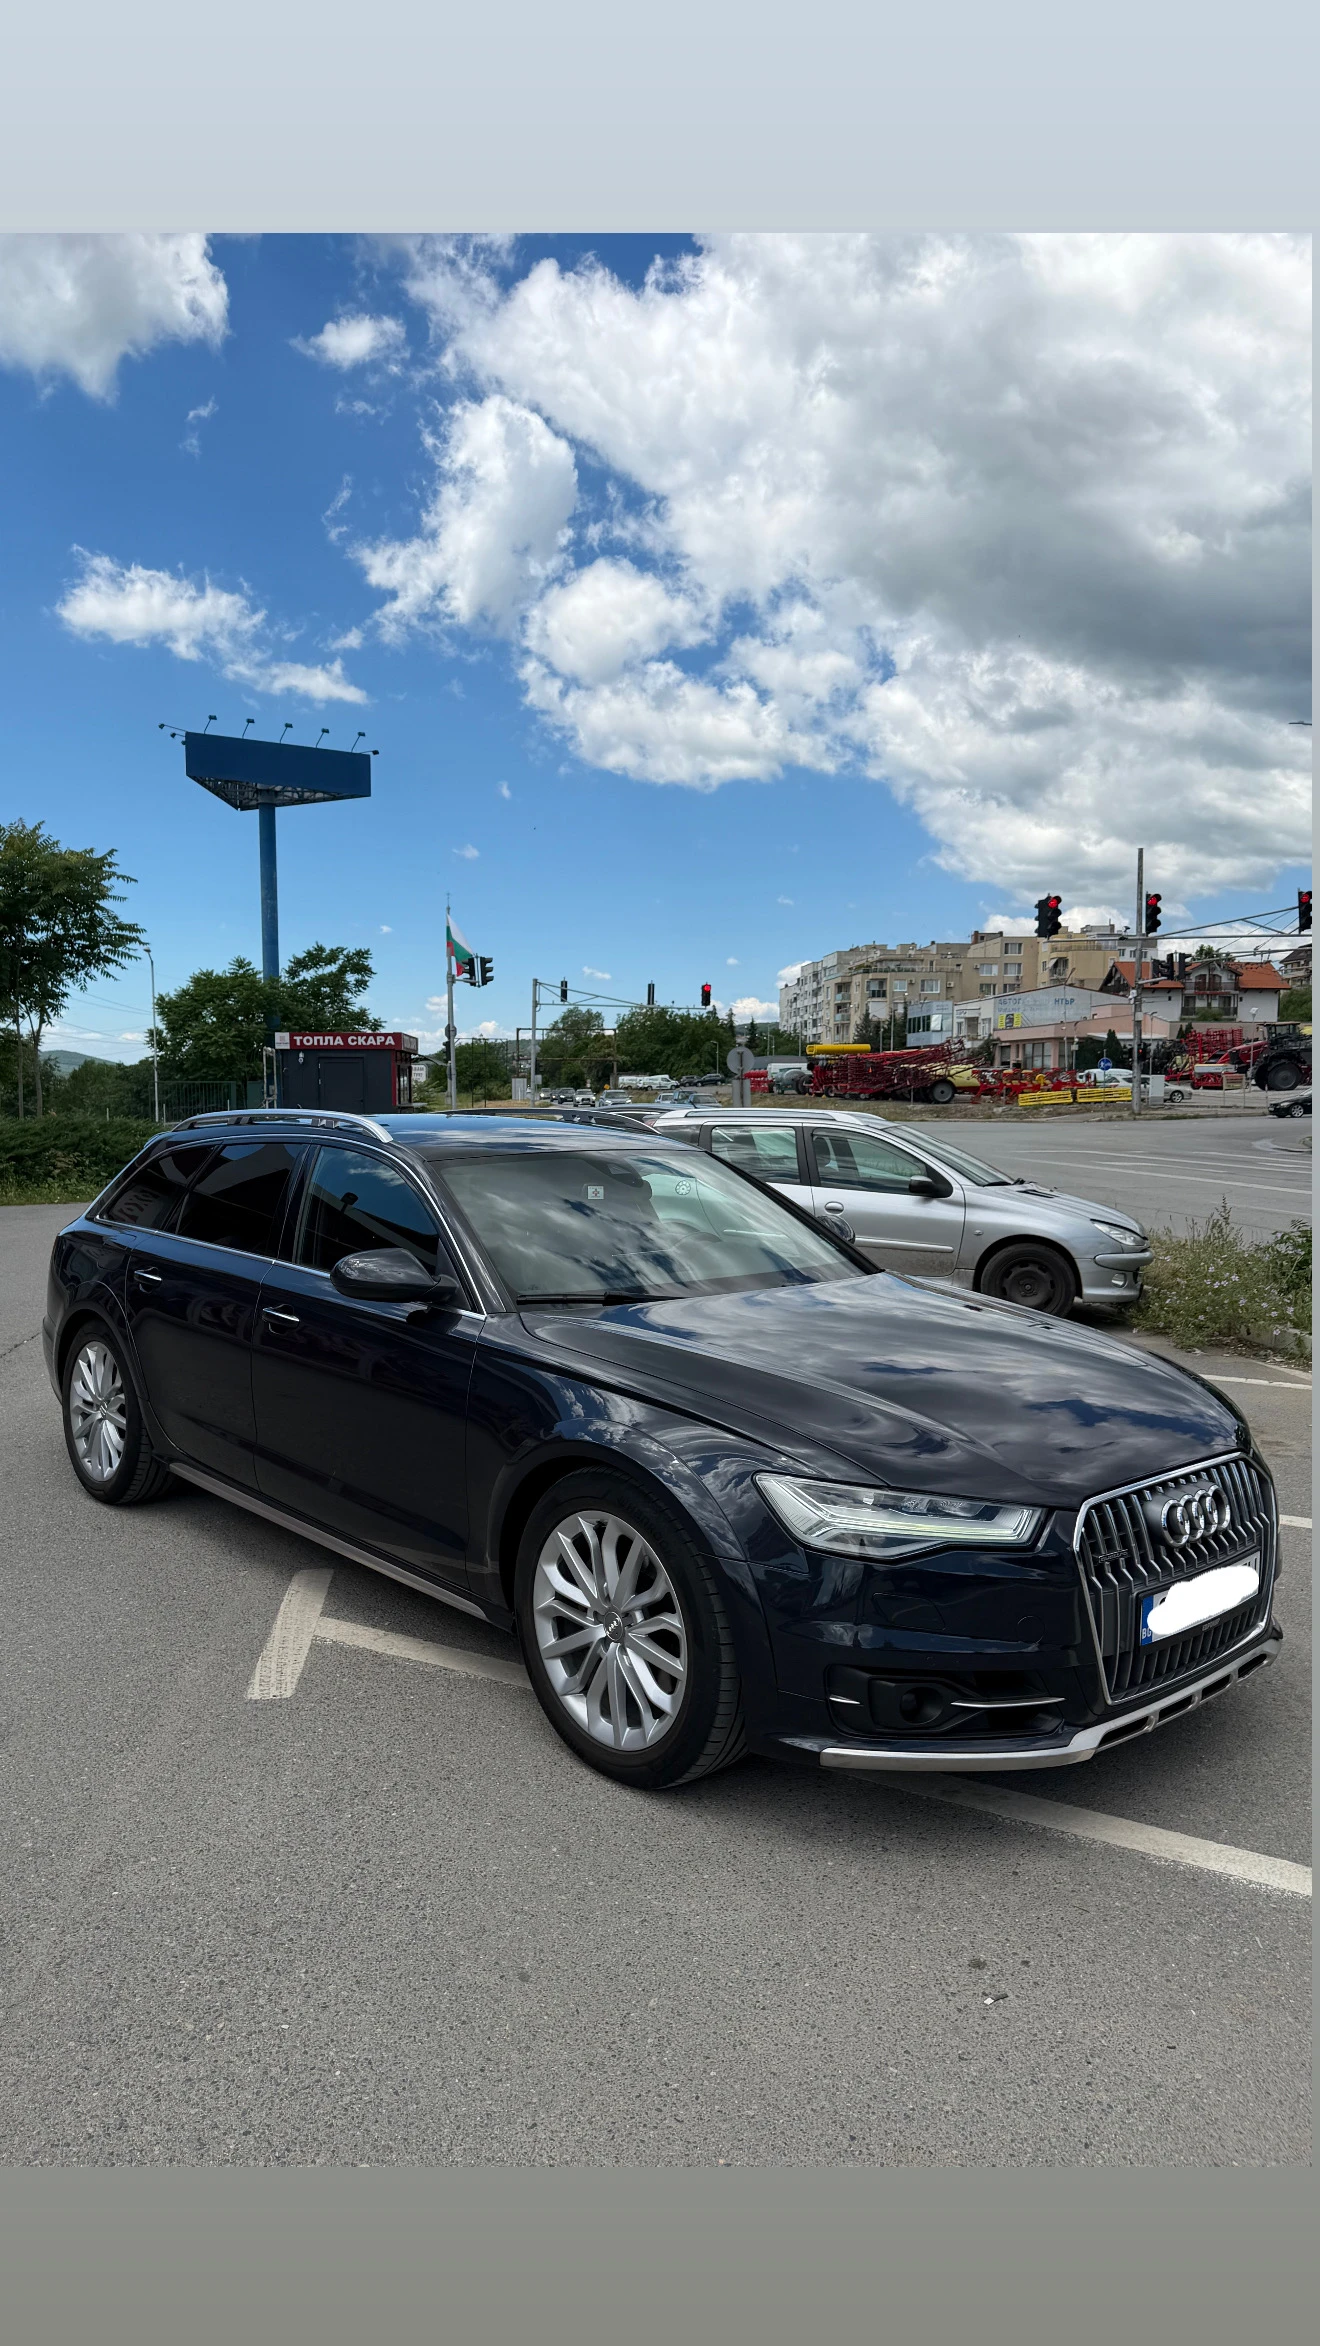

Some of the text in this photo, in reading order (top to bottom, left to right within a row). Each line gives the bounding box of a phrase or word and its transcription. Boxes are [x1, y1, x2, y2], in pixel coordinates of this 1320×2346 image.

[293, 1036, 343, 1046] ТОПЛА
[348, 1036, 395, 1046] СКАРА
[1142, 1627, 1152, 1640] BG
